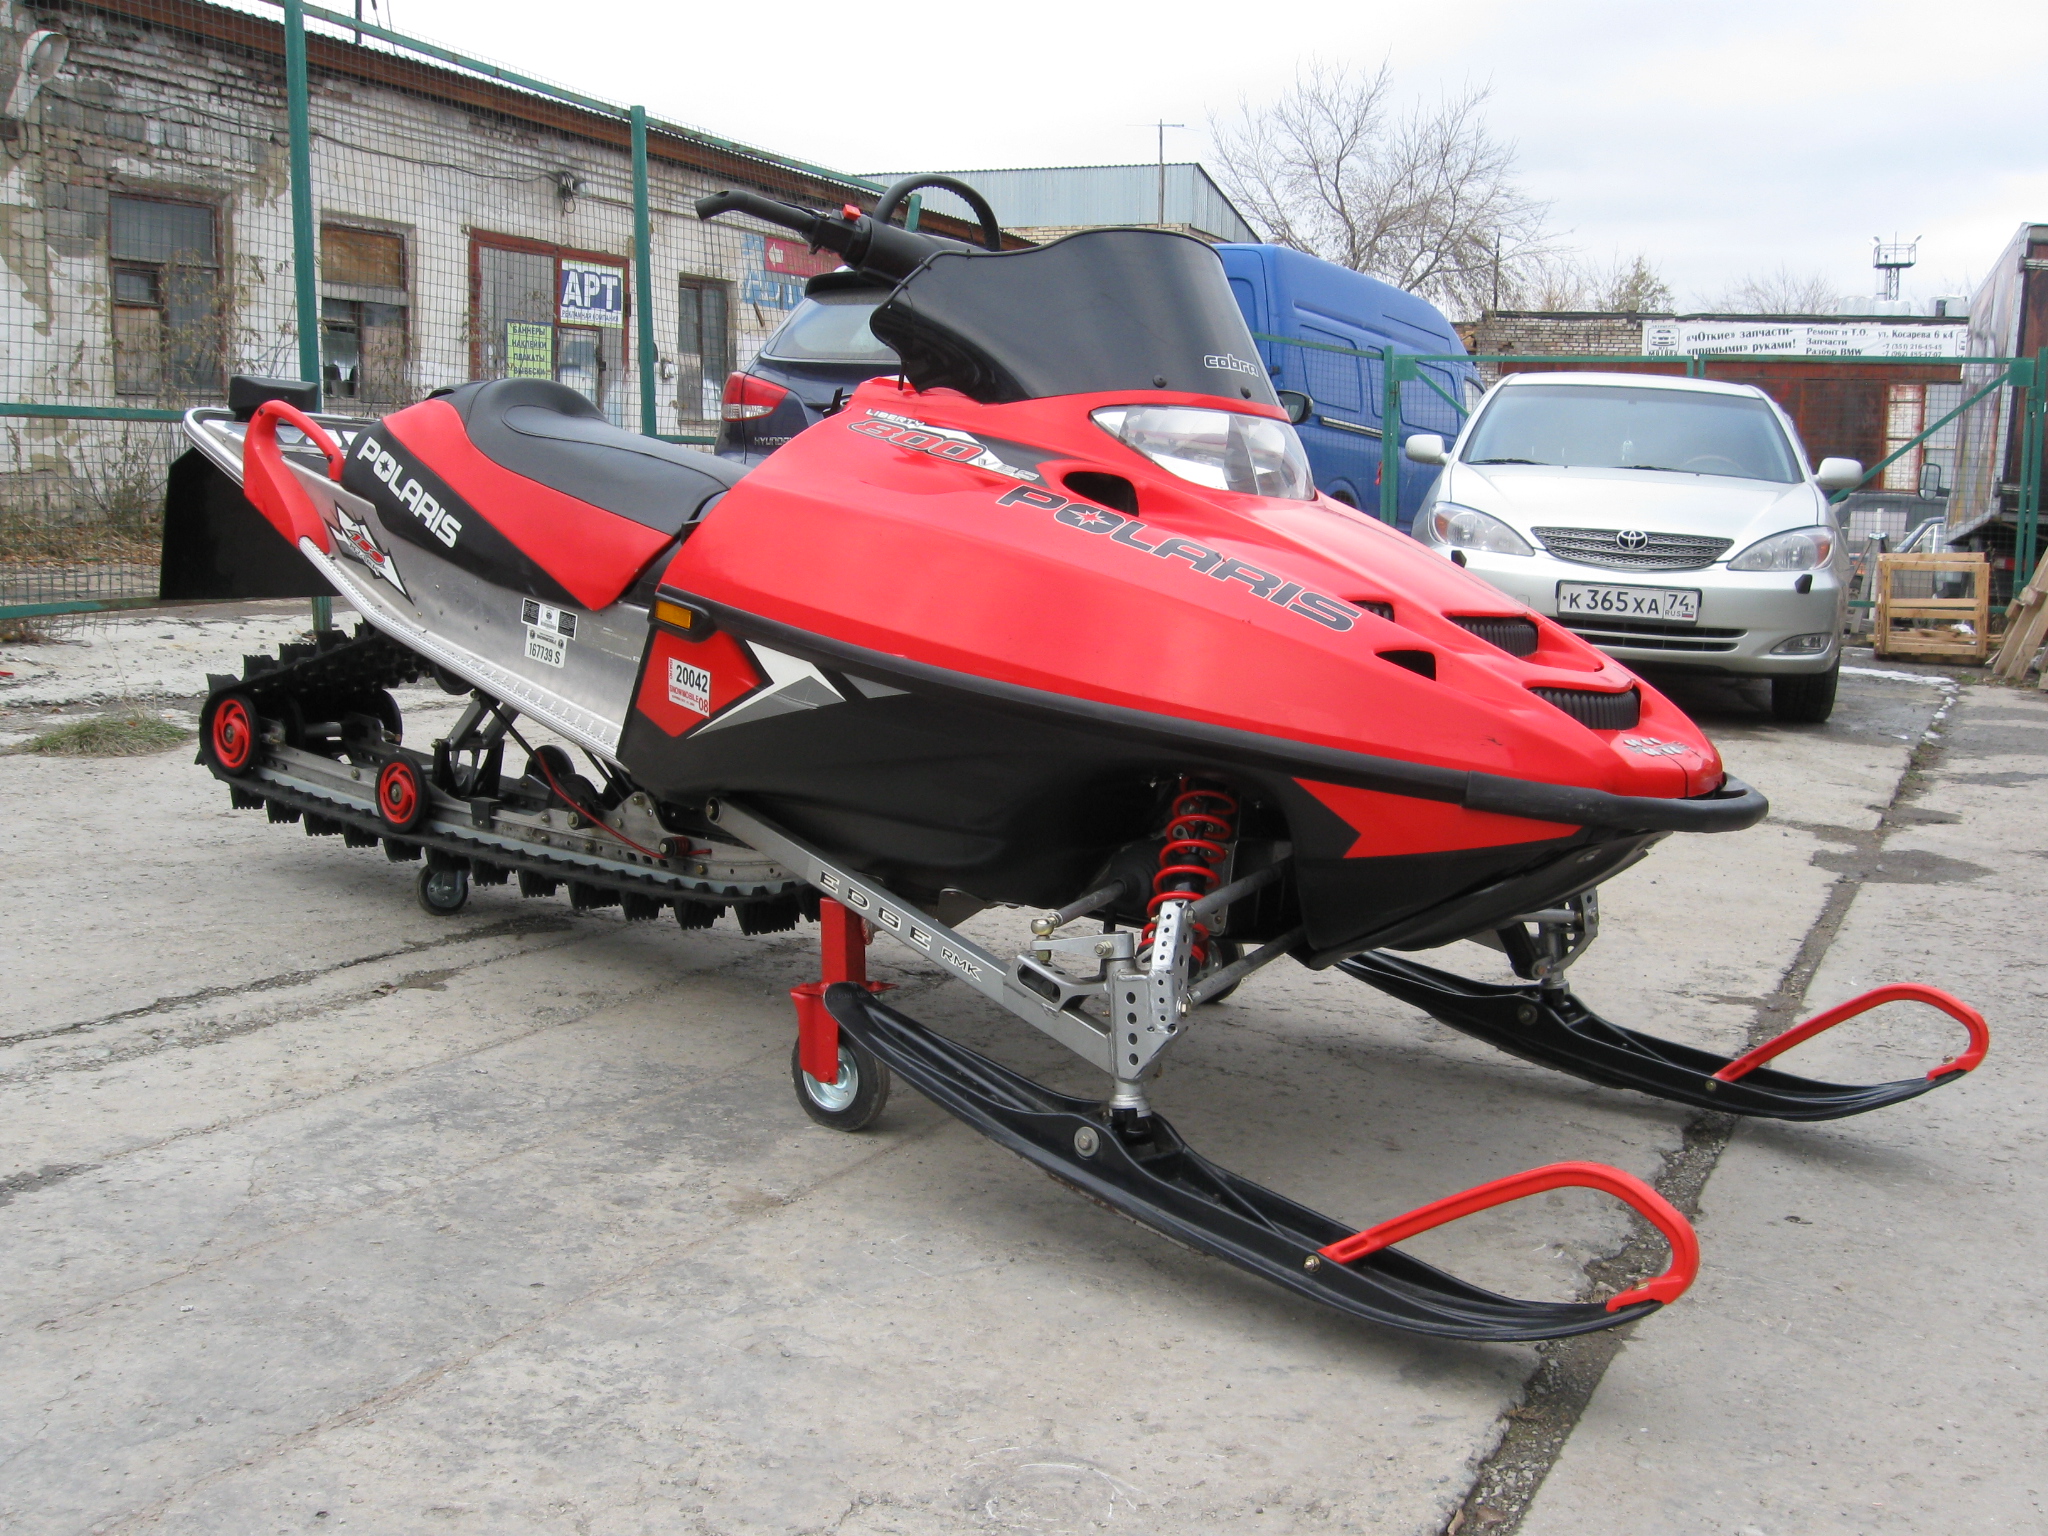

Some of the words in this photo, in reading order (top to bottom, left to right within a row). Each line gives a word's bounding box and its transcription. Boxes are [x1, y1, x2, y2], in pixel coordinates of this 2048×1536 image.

[561, 269, 620, 312] АРТ
[561, 309, 592, 321] РЕКЛАМНАЯ
[512, 324, 546, 335] БАННЕРЫ
[1806, 328, 1839, 336] Ремонт
[1891, 330, 1931, 339] Косарева
[511, 339, 547, 349] НАКЛЕЙКИ
[1752, 339, 1797, 353] руками!
[1806, 338, 1848, 346] Запчасти
[513, 352, 546, 362] ПЛАКАТЫ
[1805, 347, 1838, 356] Разбор
[1840, 348, 1864, 356] BMW
[513, 366, 546, 376] ВЫВЕСКИ
[866, 408, 926, 427] LIBERTY
[847, 418, 988, 463] 800
[356, 436, 463, 548] POLARIS
[995, 484, 1363, 632] POLARIS
[1667, 593, 1690, 612] 74
[1665, 609, 1681, 617] RUS
[529, 642, 553, 663] 167739
[554, 651, 561, 664] S
[676, 664, 708, 693] 20042
[698, 697, 709, 713] 08
[819, 869, 932, 951] EDGE
[941, 946, 982, 982] RMK
